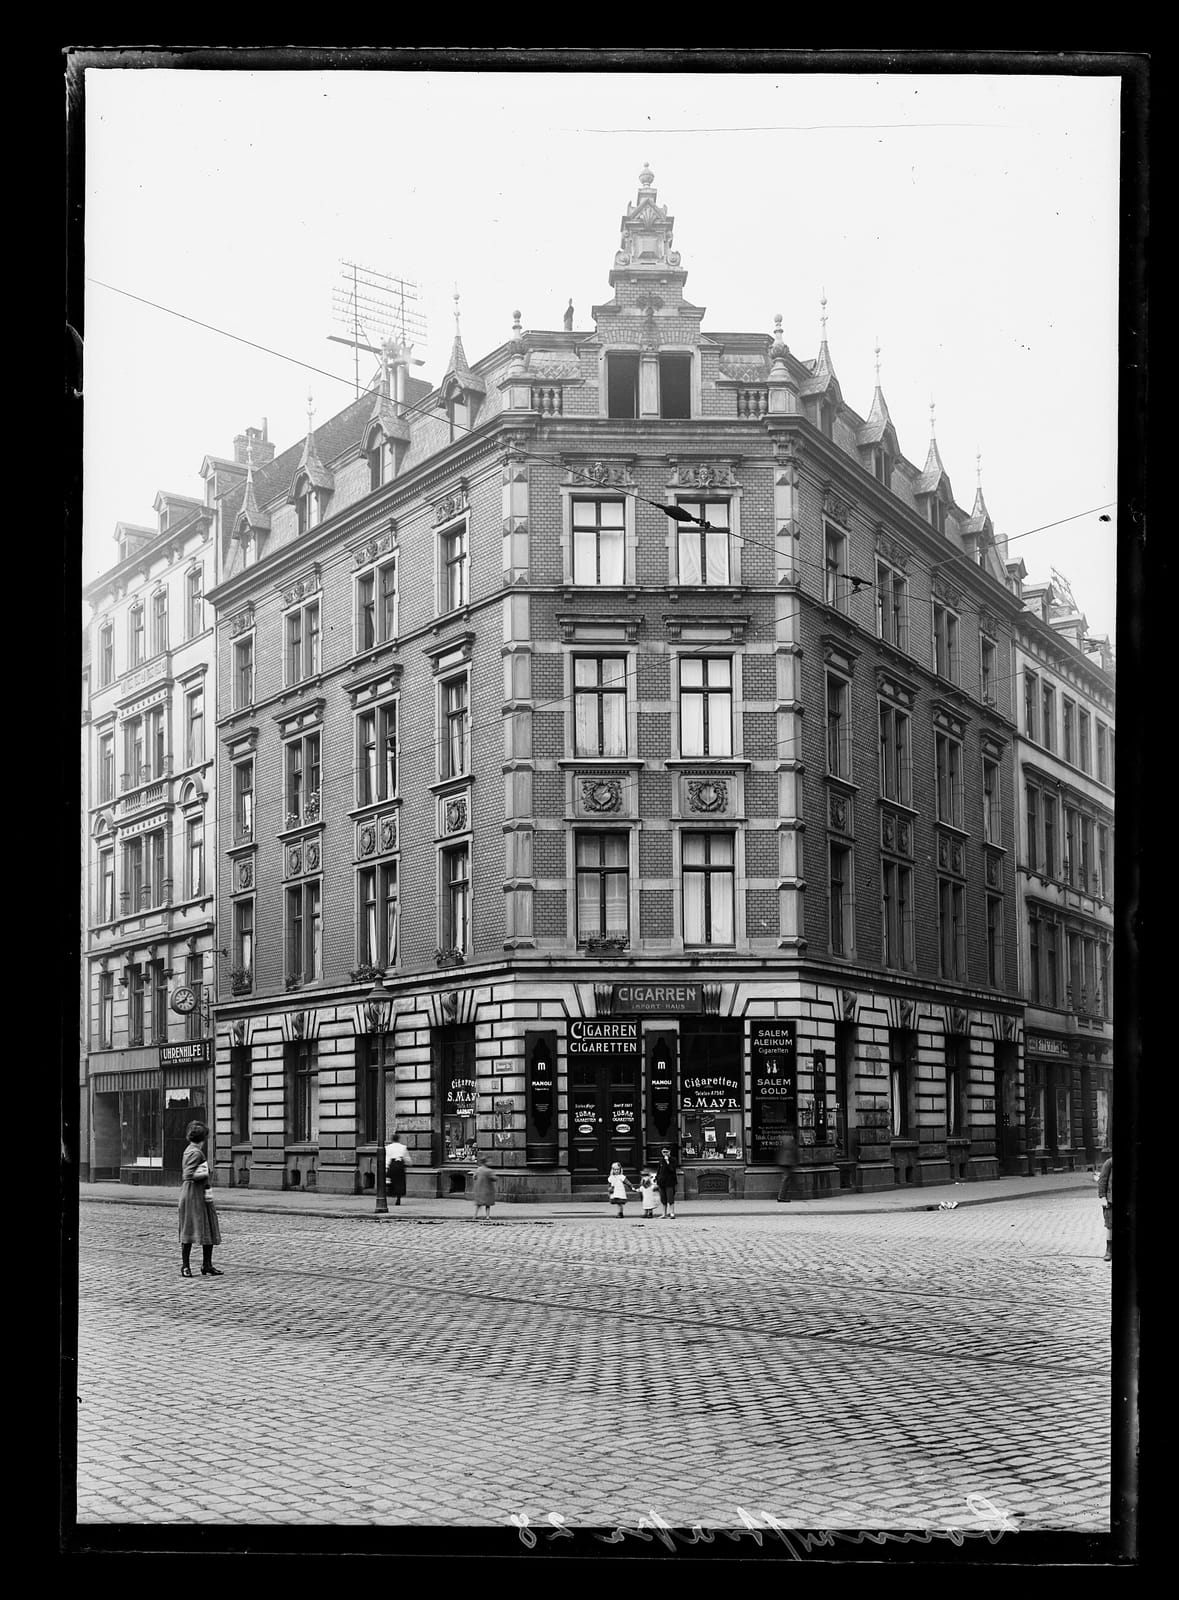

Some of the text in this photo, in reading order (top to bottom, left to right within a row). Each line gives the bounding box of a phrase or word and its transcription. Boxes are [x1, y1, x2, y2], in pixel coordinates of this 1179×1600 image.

[618, 987, 697, 1001] CIGARREN
[570, 1021, 637, 1039] CIGARREN
[758, 1029, 789, 1037] SALEM
[753, 1038, 793, 1046] ALEIKUM
[163, 1044, 201, 1059] UHRENHILFE
[570, 1042, 637, 1053] CIGARETTEN
[758, 1047, 789, 1055] Cigaretten
[684, 1076, 738, 1089] Cigaretten
[757, 1078, 791, 1086] SALEM
[760, 1087, 788, 1095] GOLD
